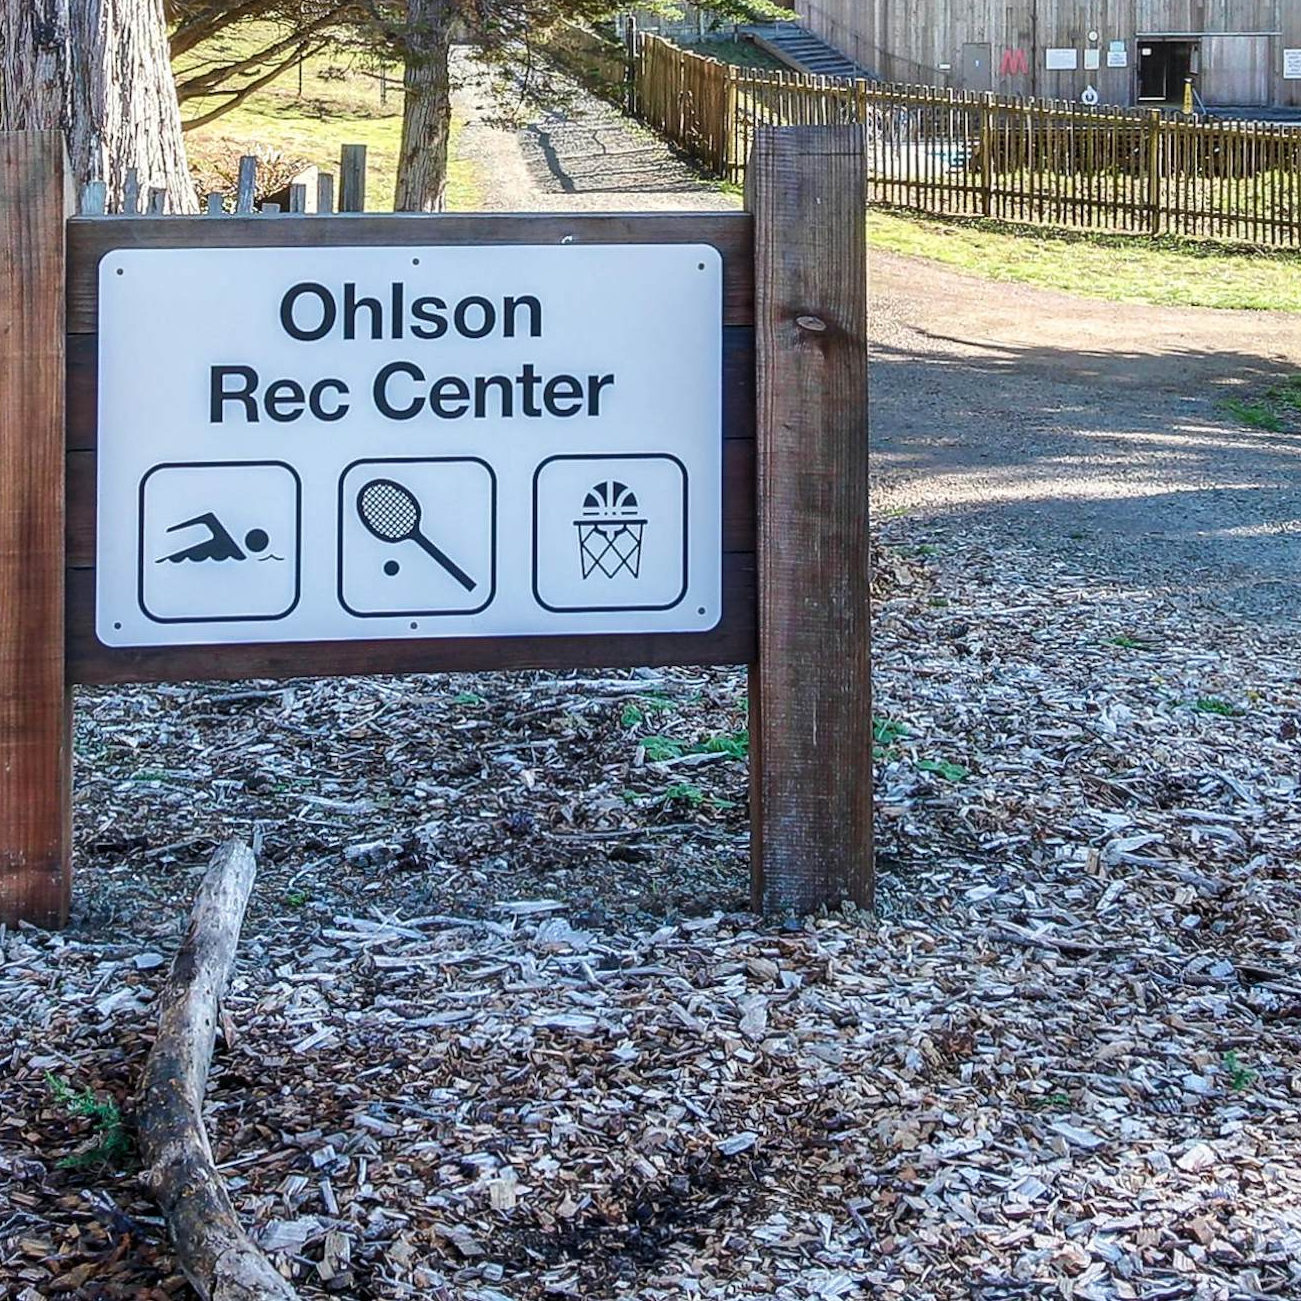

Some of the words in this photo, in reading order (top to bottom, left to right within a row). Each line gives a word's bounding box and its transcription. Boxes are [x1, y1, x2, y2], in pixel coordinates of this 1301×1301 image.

[279, 282, 542, 341] Ohlson
[210, 365, 350, 423] Rec
[373, 361, 614, 421] Center
